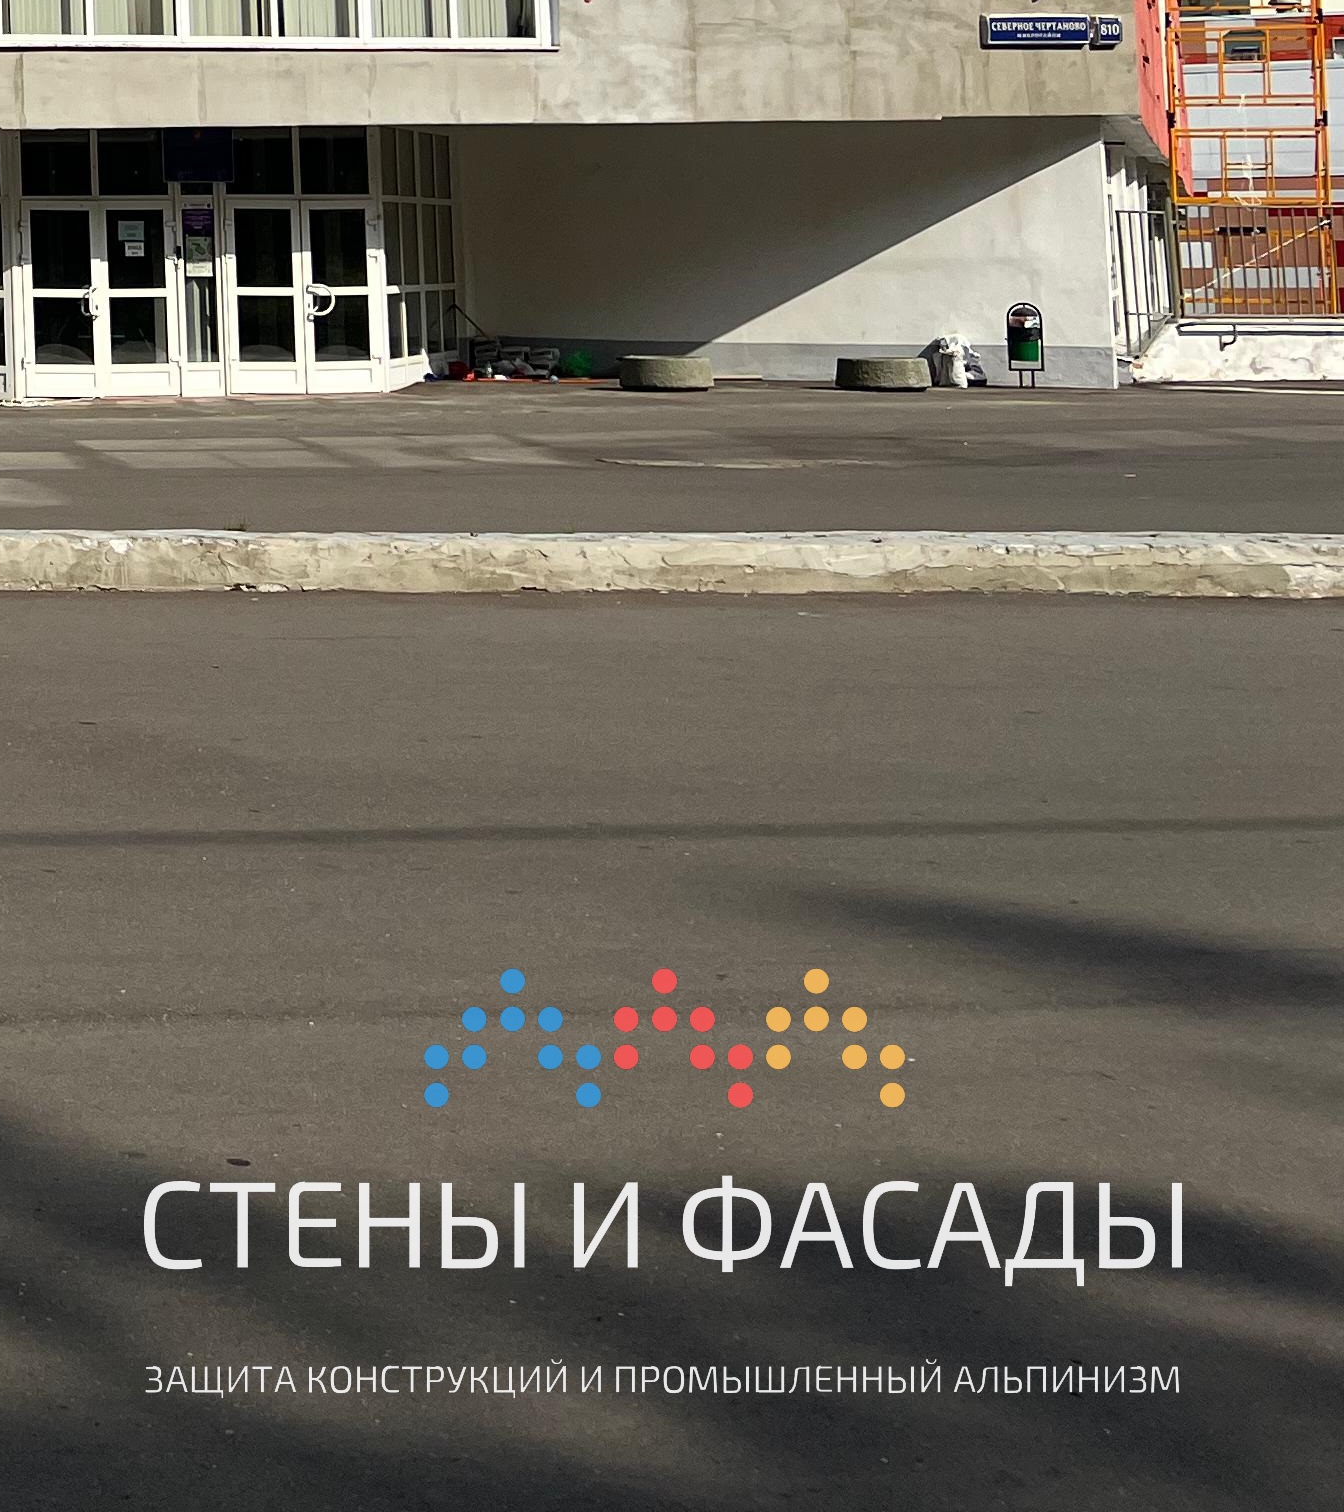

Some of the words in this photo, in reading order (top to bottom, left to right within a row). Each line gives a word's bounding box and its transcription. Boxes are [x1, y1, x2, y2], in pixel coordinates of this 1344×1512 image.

[991, 21, 1034, 31] СЕВЕРНОЕ
[1035, 21, 1086, 31] ЧЕРТАНОВО
[1100, 23, 1120, 35] 810
